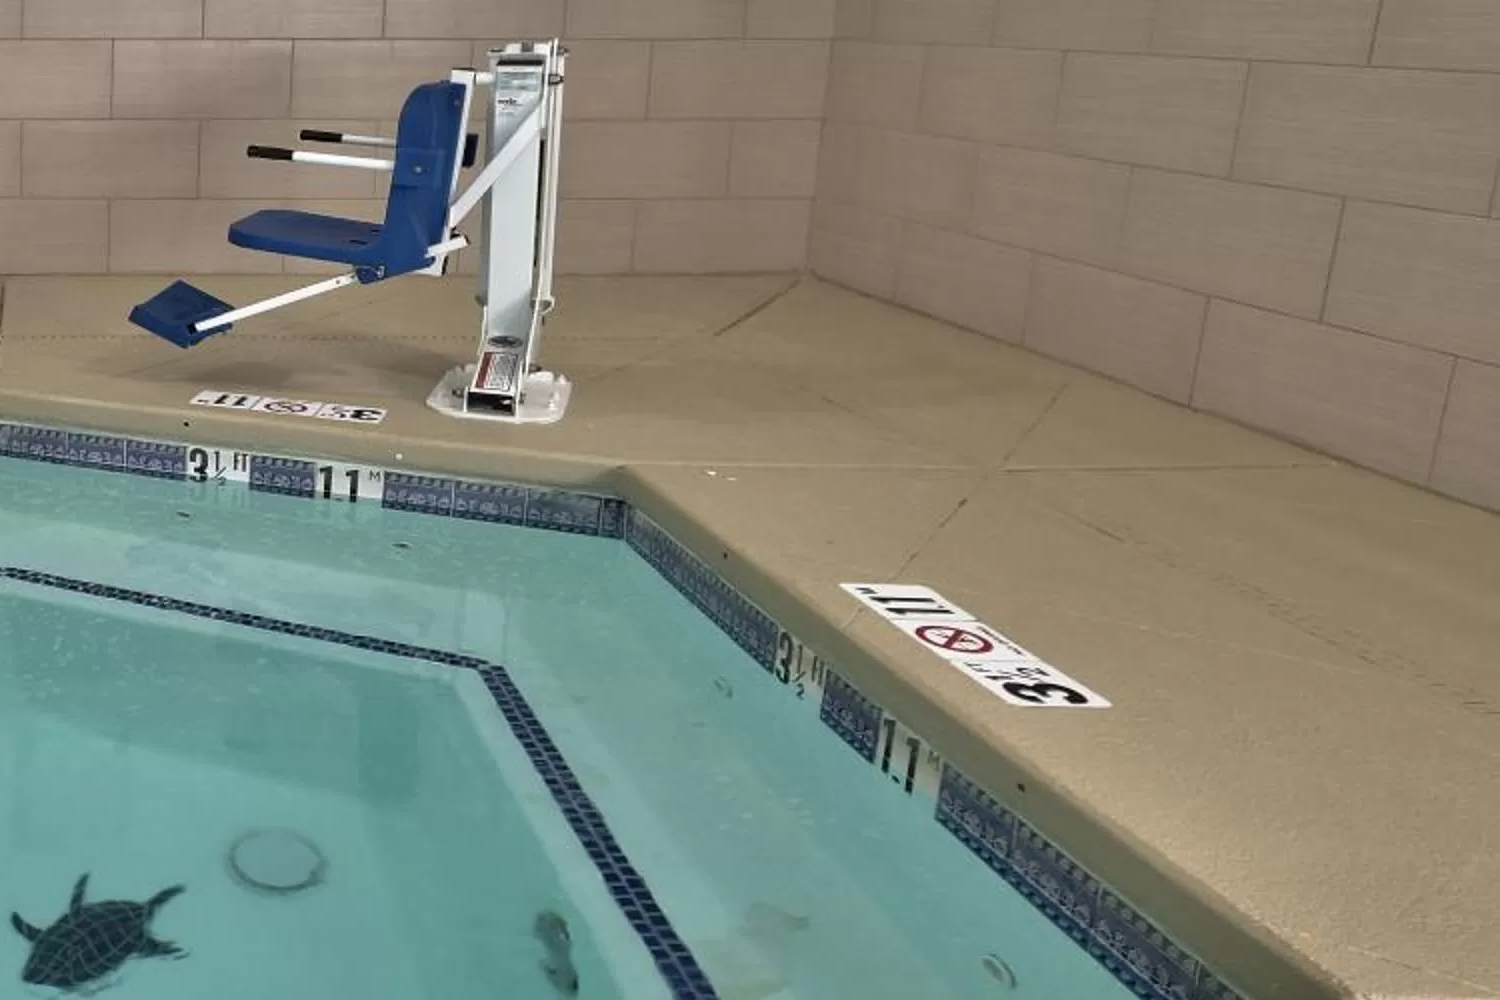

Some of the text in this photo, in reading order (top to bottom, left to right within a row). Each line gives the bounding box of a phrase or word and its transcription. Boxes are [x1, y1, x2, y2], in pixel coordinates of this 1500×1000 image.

[189, 448, 209, 483] 3
[233, 451, 249, 473] FT
[369, 470, 381, 483] M
[869, 596, 956, 615] 1.1
[775, 631, 794, 684] 3
[1002, 681, 1089, 704] 3
